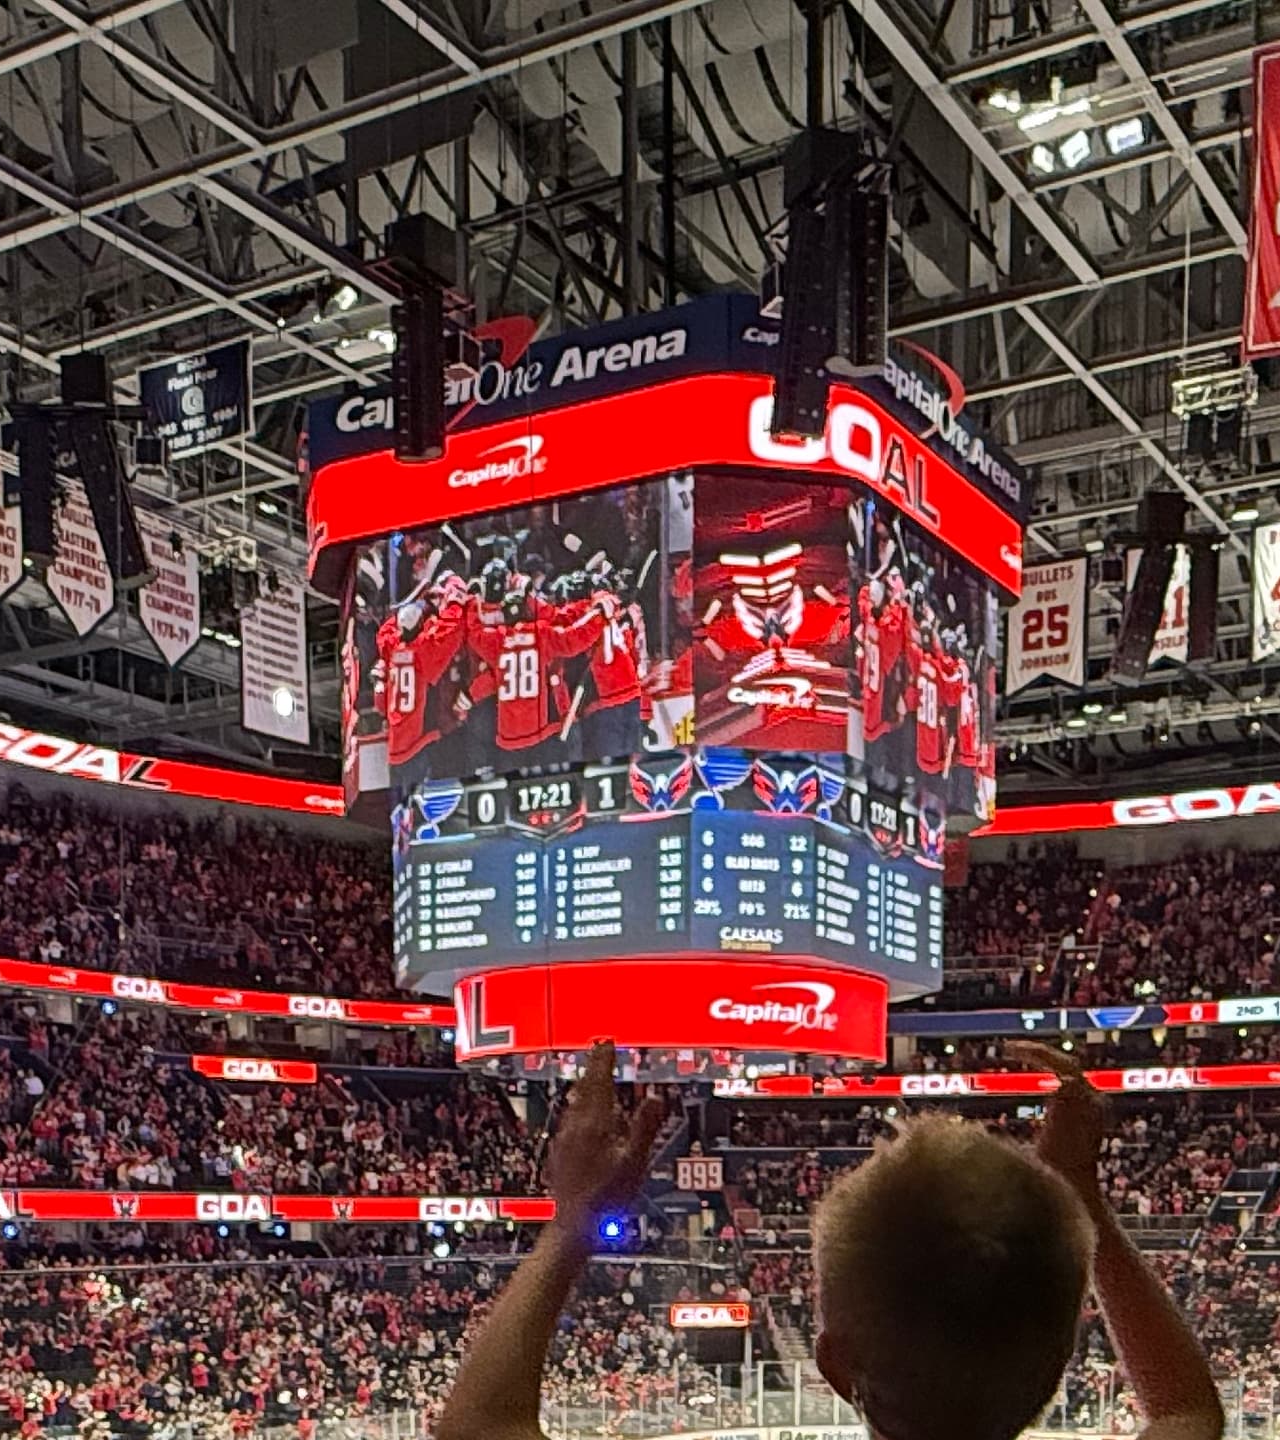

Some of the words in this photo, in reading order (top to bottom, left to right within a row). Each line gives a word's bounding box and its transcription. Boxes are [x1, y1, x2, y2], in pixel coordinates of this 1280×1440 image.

[550, 329, 687, 387] Arena
[448, 458, 515, 489] Capital
[968, 438, 1021, 502] Arena
[1022, 604, 1070, 653] 25
[1019, 651, 1071, 672] JOHNSON
[498, 648, 539, 702] 38
[477, 793, 496, 823] 0
[518, 782, 572, 812] 17:21
[599, 777, 616, 810] 1
[702, 830, 714, 847] 6
[702, 876, 714, 893] 6
[791, 881, 803, 897] 6
[720, 927, 784, 945] CAESARS
[112, 974, 176, 1003] GOAL
[288, 996, 358, 1020] GOAL
[709, 997, 802, 1028] Capital
[222, 1059, 284, 1081] GOAL
[1122, 1067, 1211, 1090] GOAL
[901, 1073, 986, 1095] GOAL
[196, 1194, 288, 1221] GOAL
[419, 1197, 517, 1221] GOAL
[673, 1306, 748, 1326] GOAL
